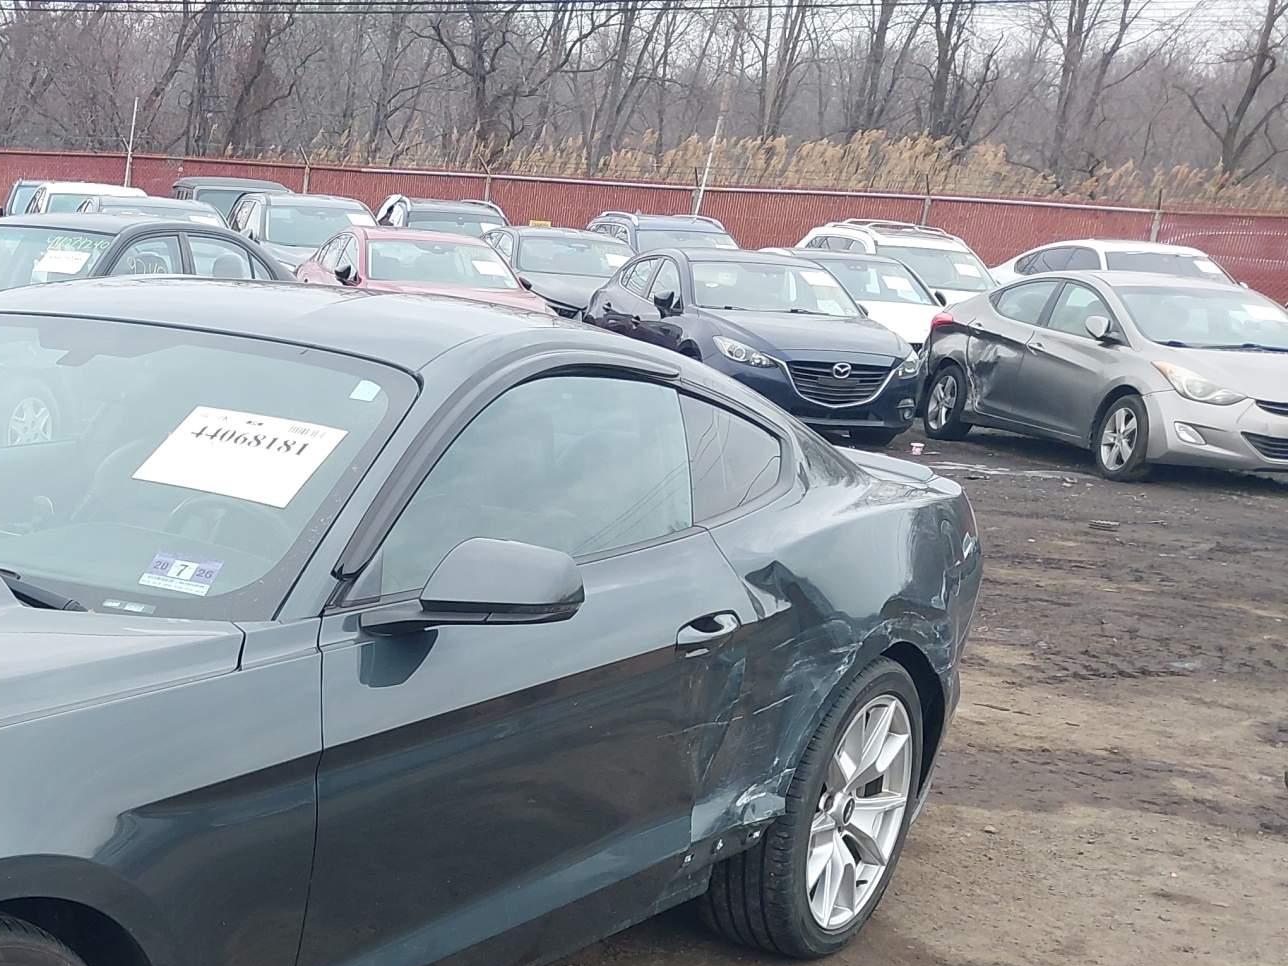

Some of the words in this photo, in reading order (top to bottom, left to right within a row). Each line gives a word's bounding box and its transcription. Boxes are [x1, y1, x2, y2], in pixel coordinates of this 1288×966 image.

[191, 426, 309, 455] 44068181
[153, 560, 169, 570] 20
[176, 564, 189, 576] 7
[196, 568, 214, 579] 26
